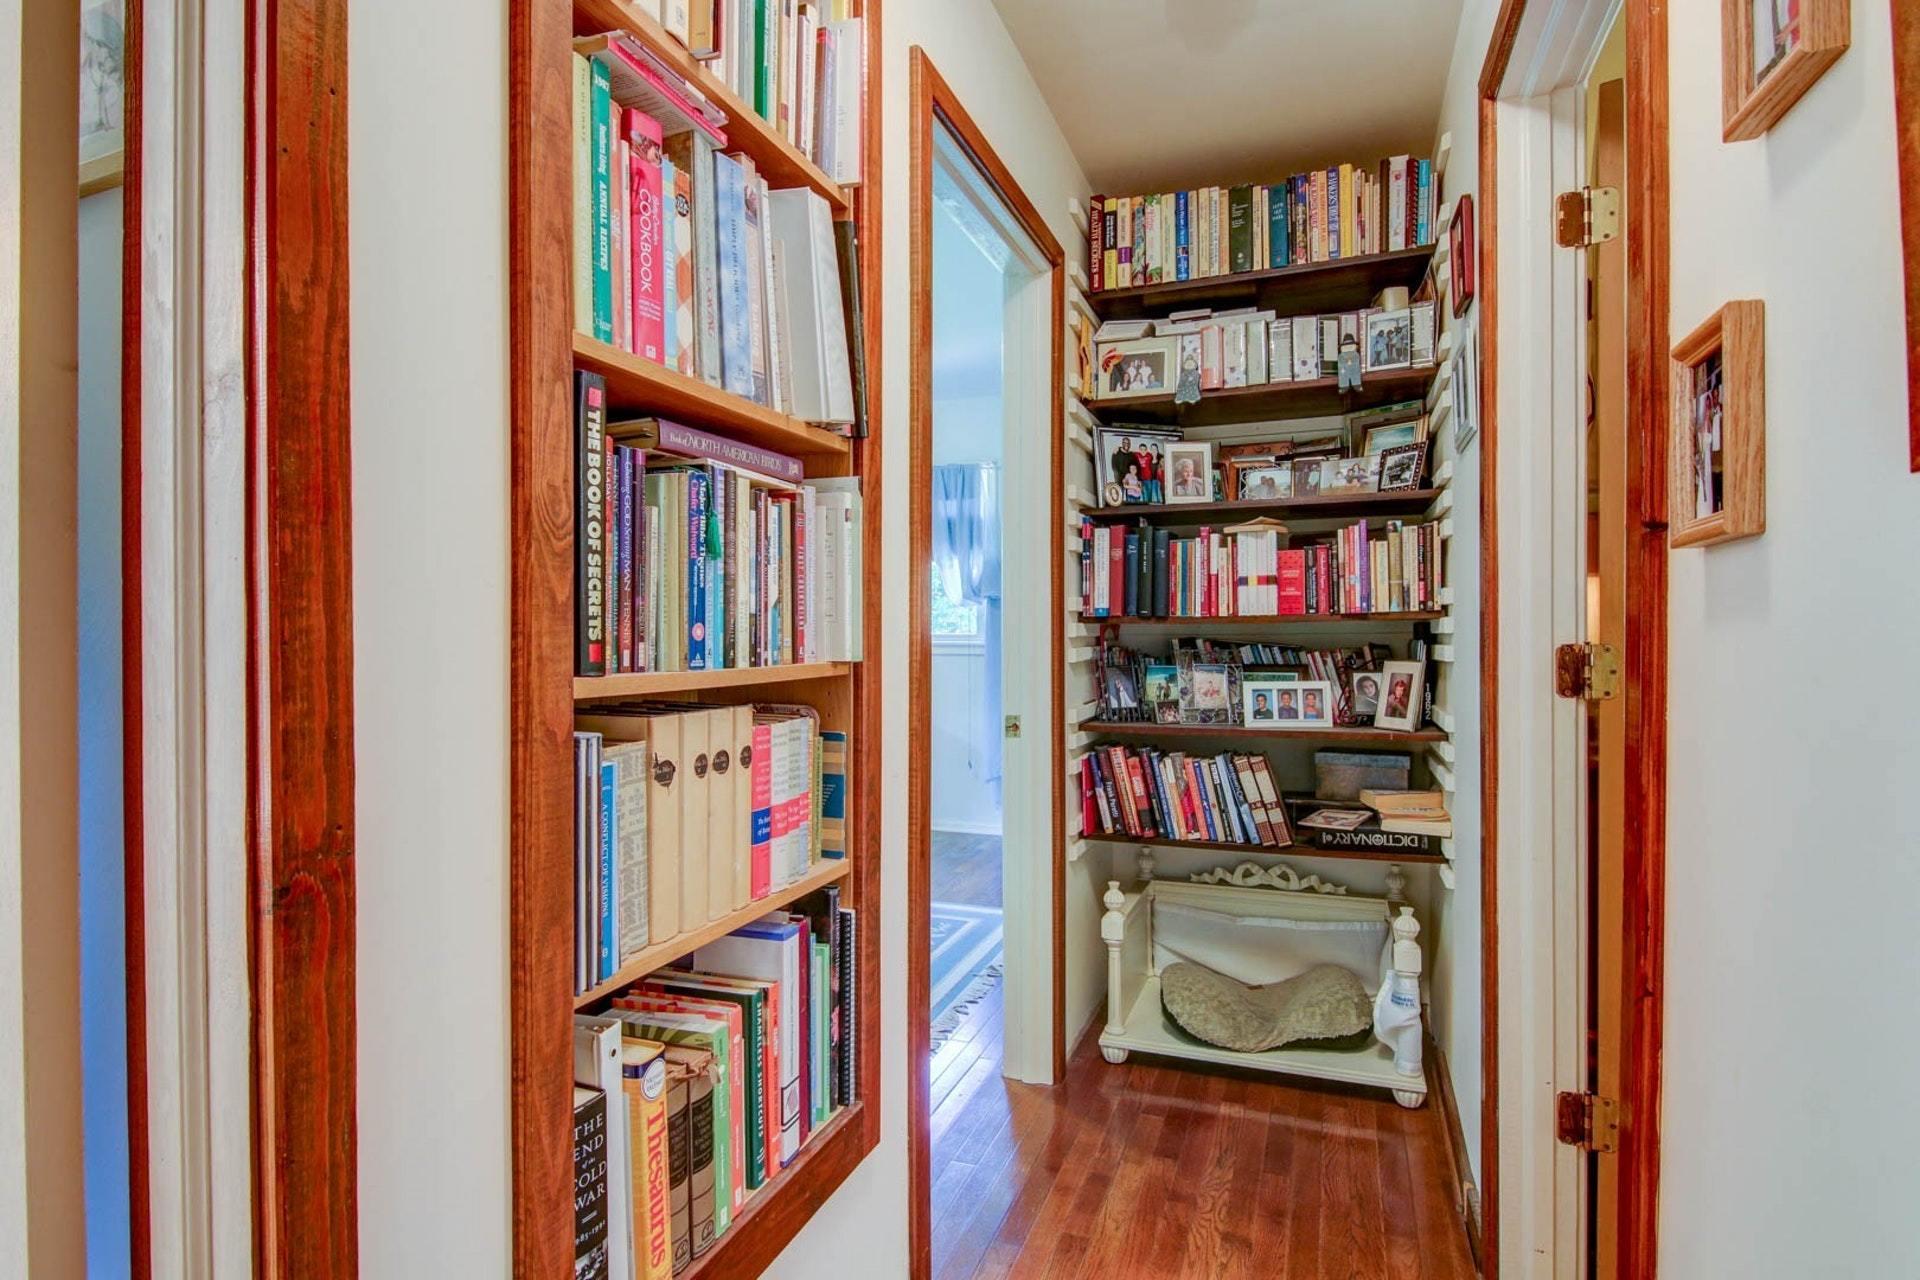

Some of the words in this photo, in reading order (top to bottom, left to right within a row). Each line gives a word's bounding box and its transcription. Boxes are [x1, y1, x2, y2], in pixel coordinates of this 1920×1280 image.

[599, 123, 607, 153] Southern
[597, 154, 607, 175] Living
[599, 180, 608, 224] ANNUAL
[600, 226, 608, 272] RECIPES
[639, 188, 652, 293] COOKBOOK
[587, 410, 601, 450] THE
[687, 433, 720, 454] NORTH
[721, 445, 760, 465] AMERICAN
[761, 454, 782, 470] BIRDS
[587, 453, 601, 519] BOOK
[587, 521, 601, 550] OF
[621, 527, 632, 560] Serving
[624, 560, 632, 591] MAN
[587, 553, 601, 641] SECRETS
[1106, 781, 1115, 798] Frank
[1333, 832, 1419, 848] DICTIONARY
[602, 863, 608, 874] OF
[574, 1113, 603, 1140] THE
[575, 1134, 604, 1161] END
[574, 1183, 606, 1212] WAR
[647, 1101, 667, 1268] Thesaurus
